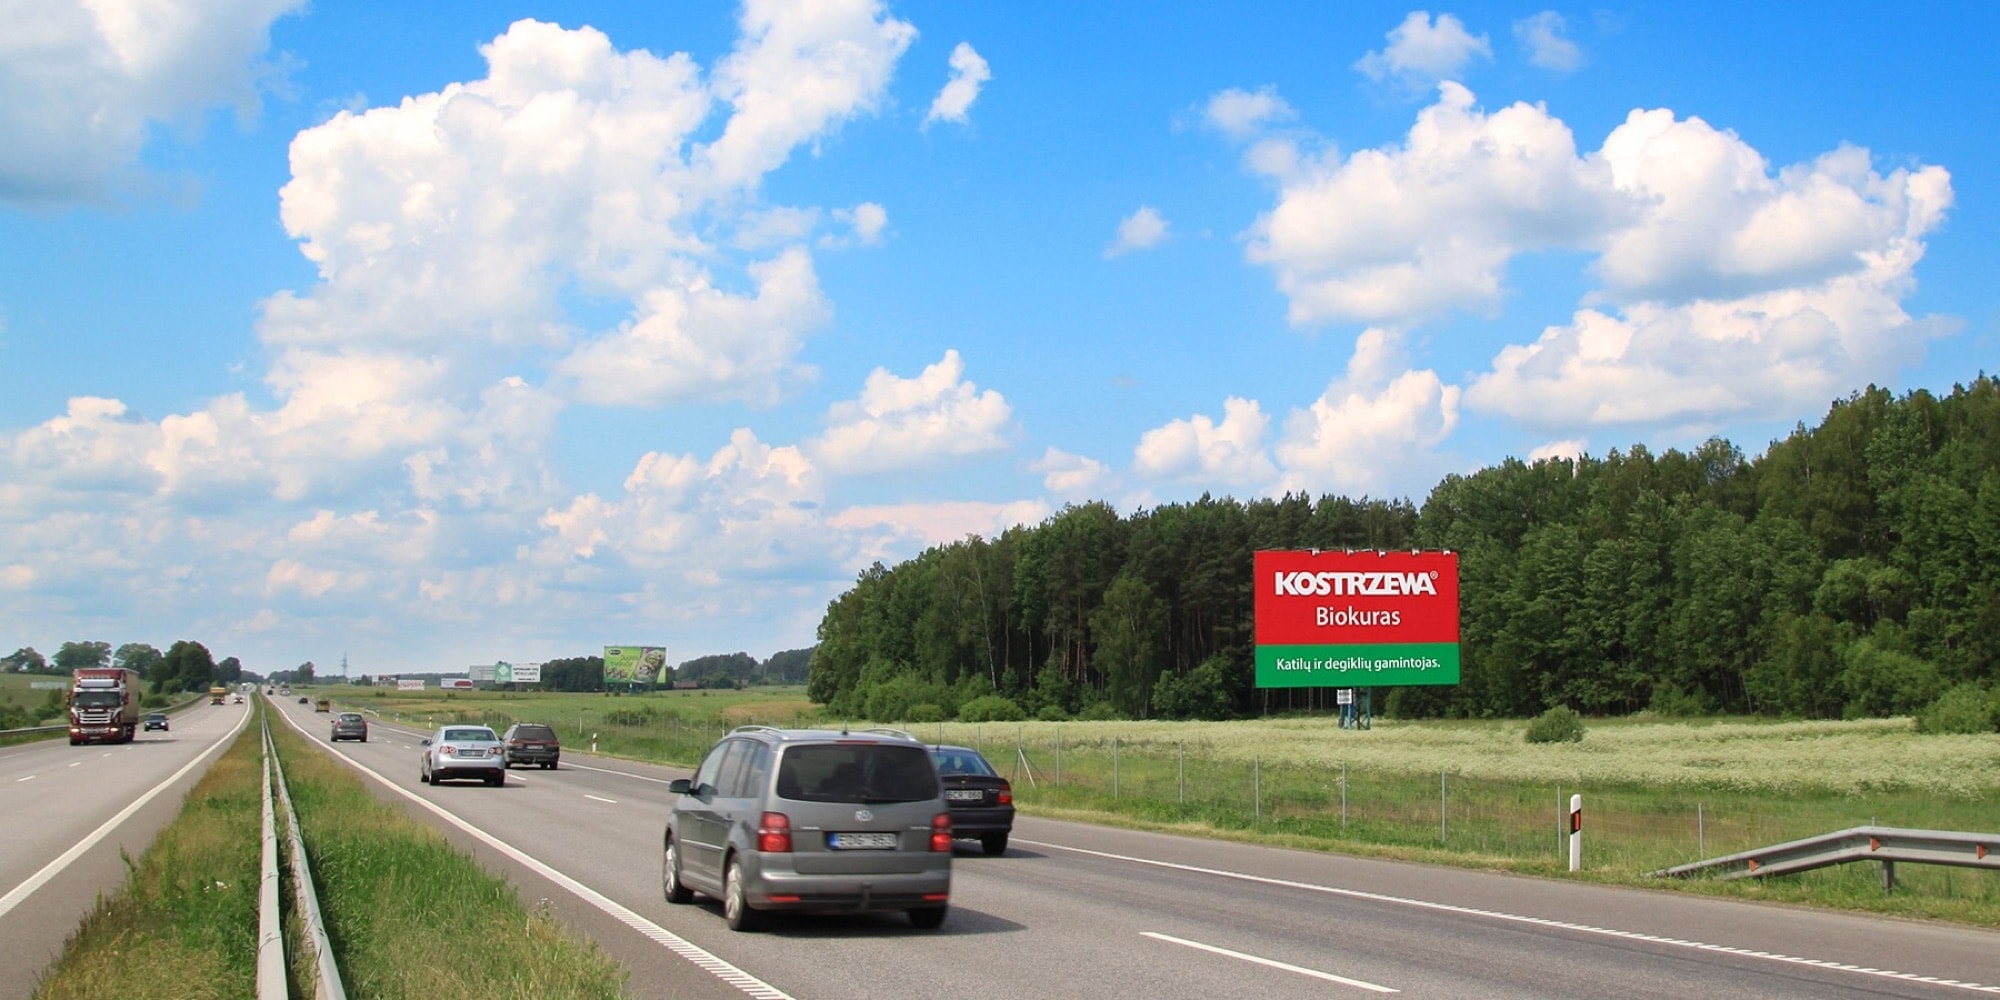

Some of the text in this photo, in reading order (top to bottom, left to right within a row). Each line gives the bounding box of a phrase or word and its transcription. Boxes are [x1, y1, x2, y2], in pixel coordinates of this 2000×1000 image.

[1316, 606, 1401, 626] Biokuras
[1276, 656, 1441, 673] Katilų ir degiklių gamintojas.
